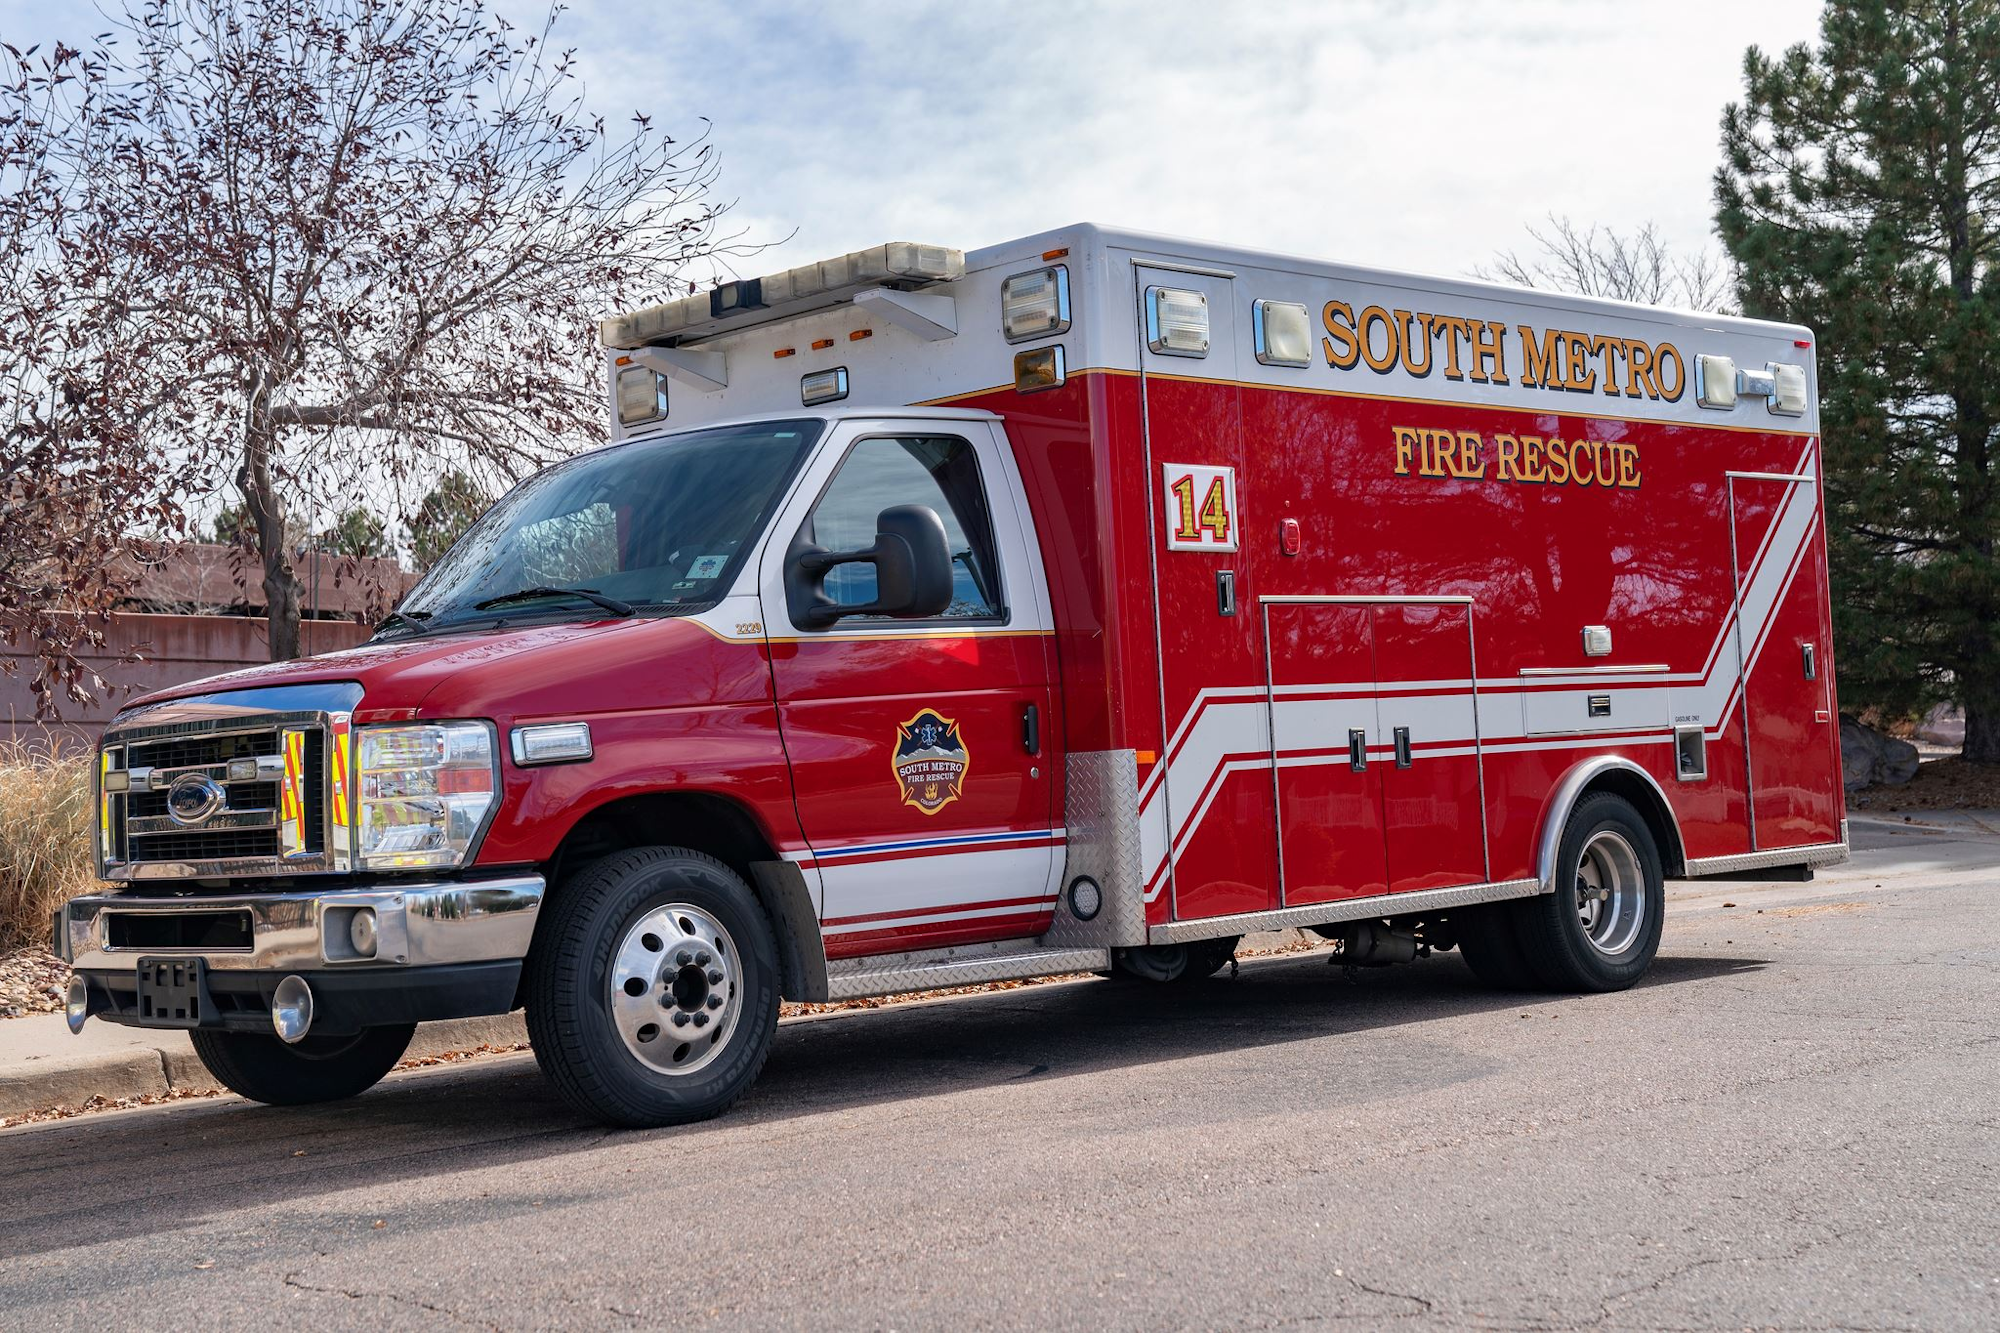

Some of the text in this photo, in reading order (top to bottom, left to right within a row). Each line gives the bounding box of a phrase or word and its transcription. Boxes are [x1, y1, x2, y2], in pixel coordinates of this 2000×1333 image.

[1322, 300, 1685, 403] SOUTH METRO
[1392, 426, 1641, 489] FIRE RESCUE
[1171, 474, 1230, 542] 14
[735, 622, 762, 634] 2229
[899, 762, 963, 777] SOUTH METRO
[907, 772, 955, 783] FIRE RESCUE
[920, 797, 943, 806] COLORADO
